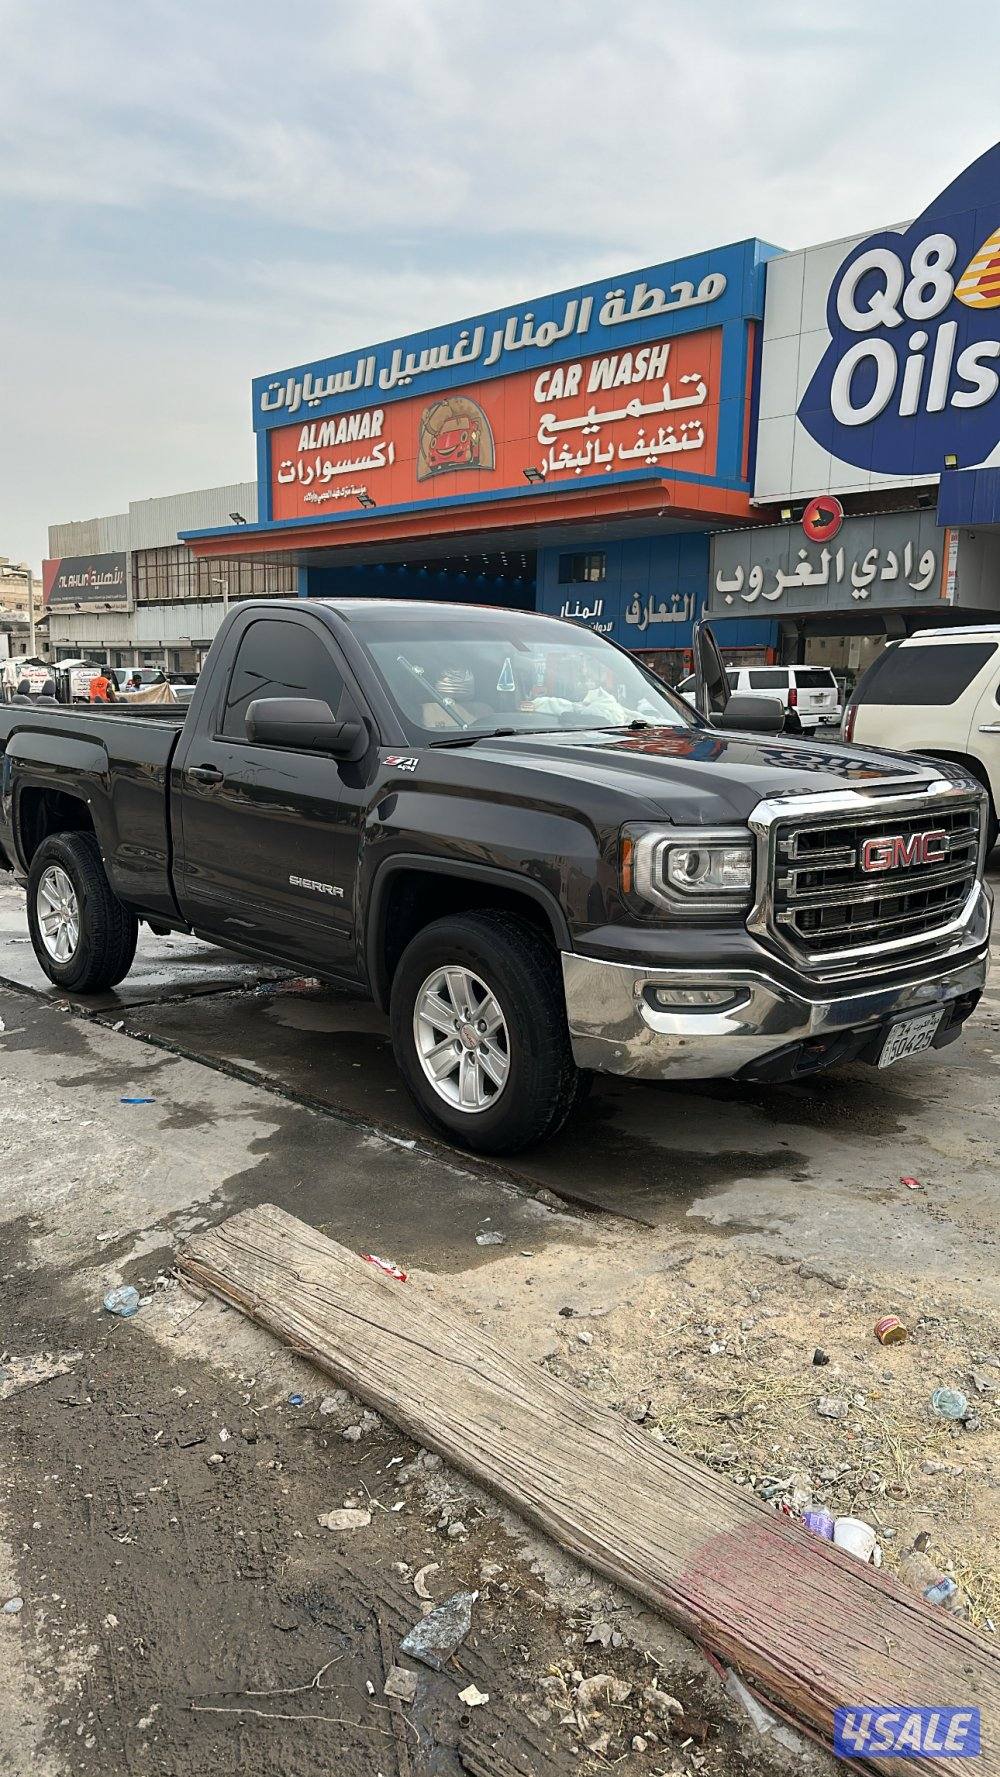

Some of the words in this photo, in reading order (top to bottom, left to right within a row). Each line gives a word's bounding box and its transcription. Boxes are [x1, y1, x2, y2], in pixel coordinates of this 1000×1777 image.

[599, 272, 727, 326] محطة
[837, 233, 957, 332] Q8
[378, 325, 485, 390] لغسيل
[483, 296, 594, 366] المنار
[260, 356, 376, 412] السيارات
[534, 363, 582, 403] CAR
[587, 344, 670, 393] WASH
[830, 320, 1000, 426] Oils
[297, 409, 385, 452] ALMANAR
[537, 373, 708, 444] تلميع
[277, 441, 395, 485] اكسسوارات
[541, 438, 615, 476] بالبخار
[618, 420, 705, 464] تنظيف
[716, 547, 845, 604] الغروب
[851, 541, 937, 600] وادي
[560, 599, 603, 619] المنار
[625, 592, 696, 631] التعارف
[861, 829, 948, 873] GMC
[289, 875, 344, 898] SIERRA
[890, 1029, 936, 1060] 50425
